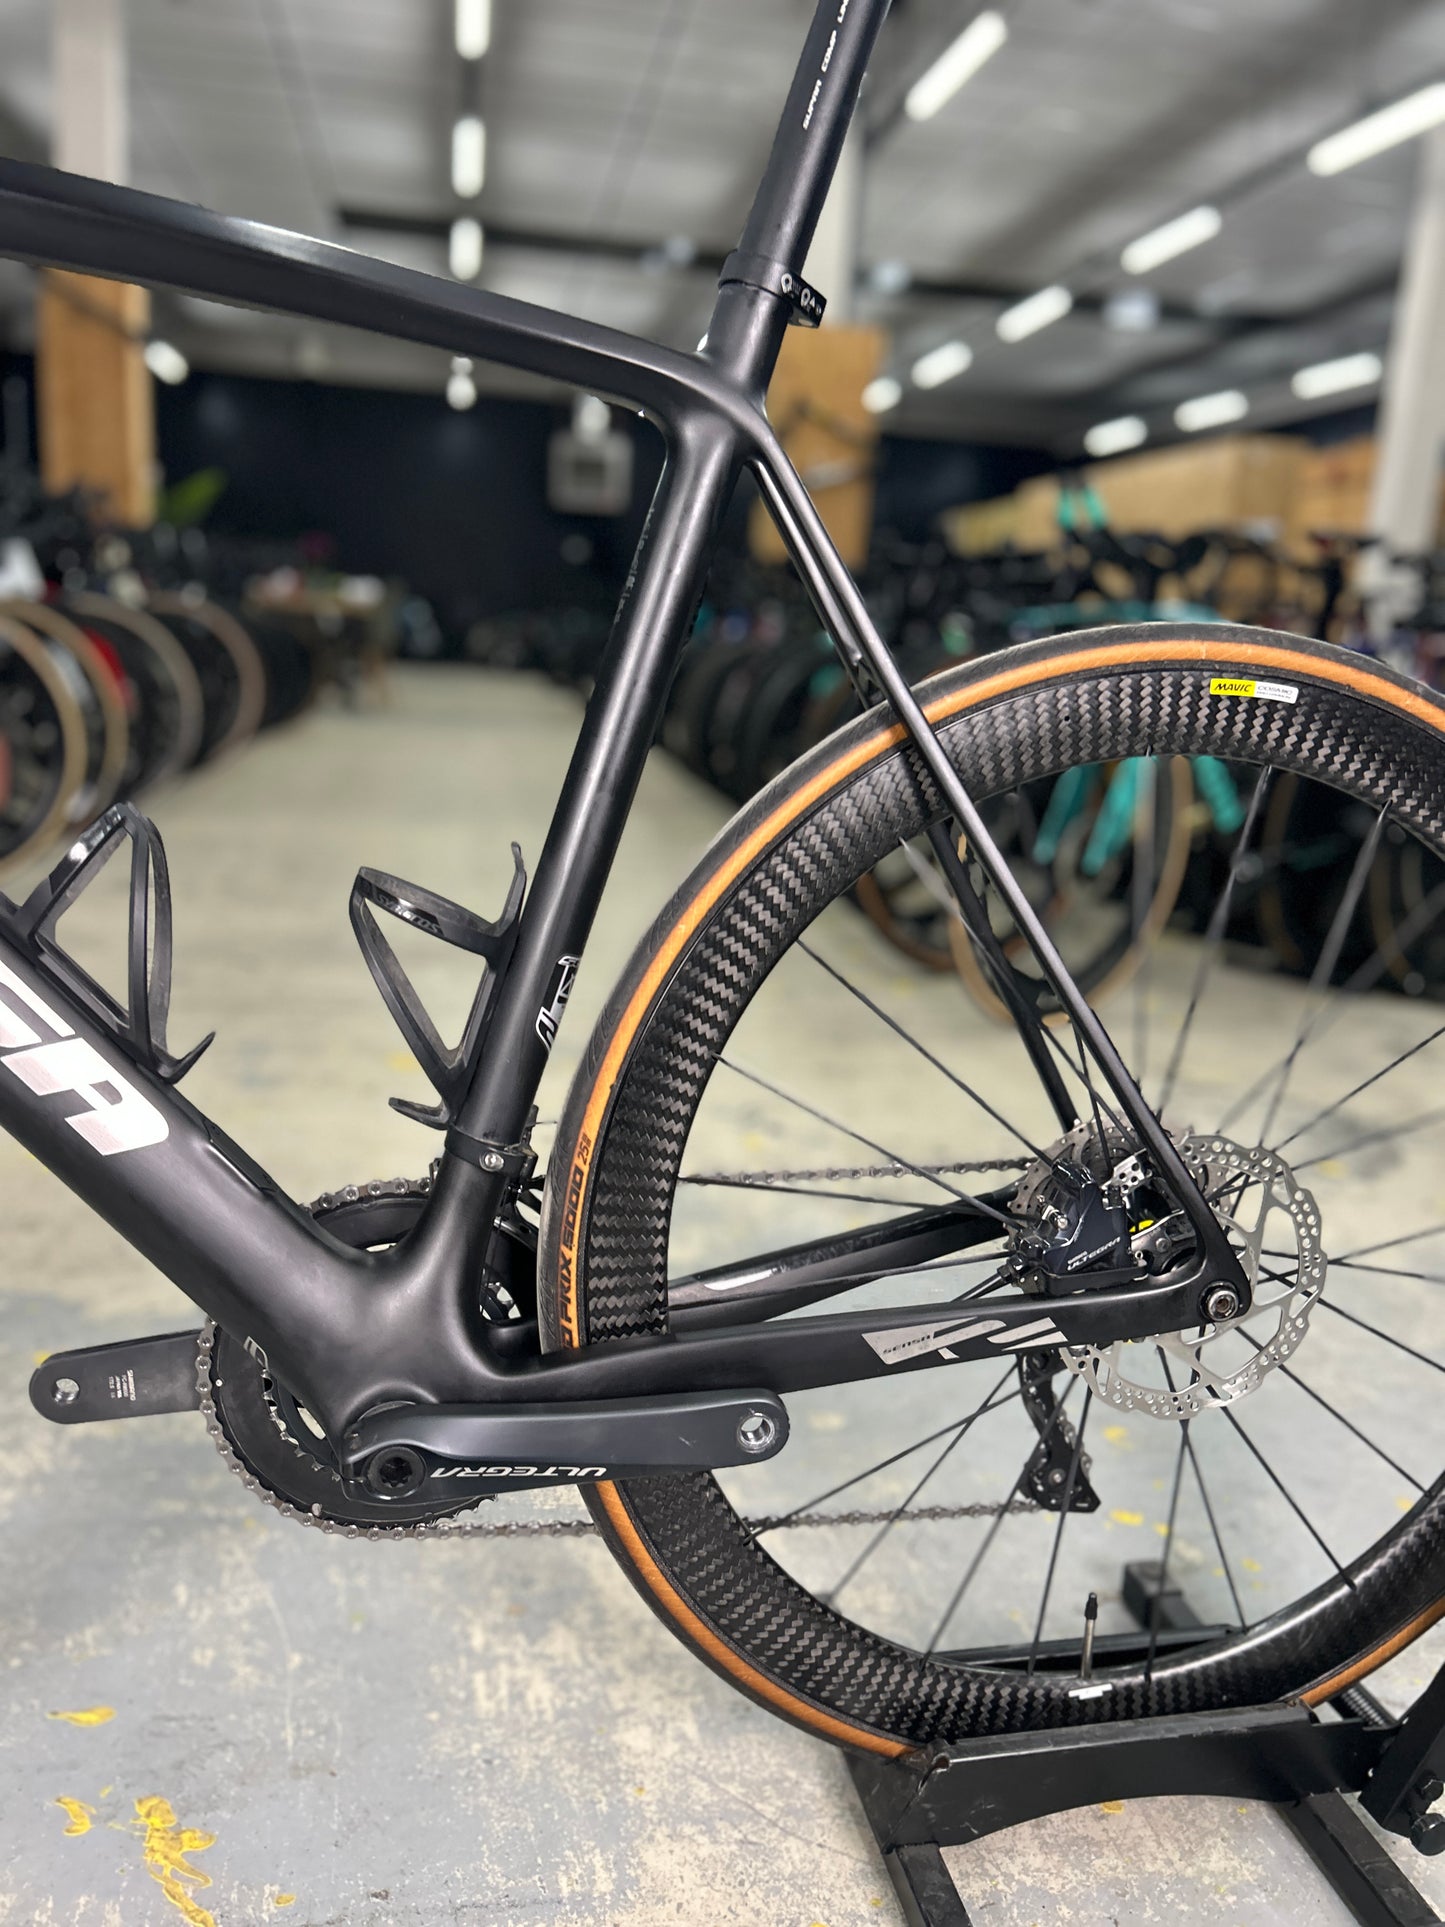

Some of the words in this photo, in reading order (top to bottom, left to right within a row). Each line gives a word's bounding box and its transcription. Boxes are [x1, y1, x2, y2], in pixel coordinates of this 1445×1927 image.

[821, 29, 837, 72] COMP
[1214, 683, 1252, 692] MAVIC
[562, 1166, 584, 1250] 5000
[1067, 1236, 1121, 1271] ULTEGRA
[429, 1466, 608, 1478] ULTEGRA
